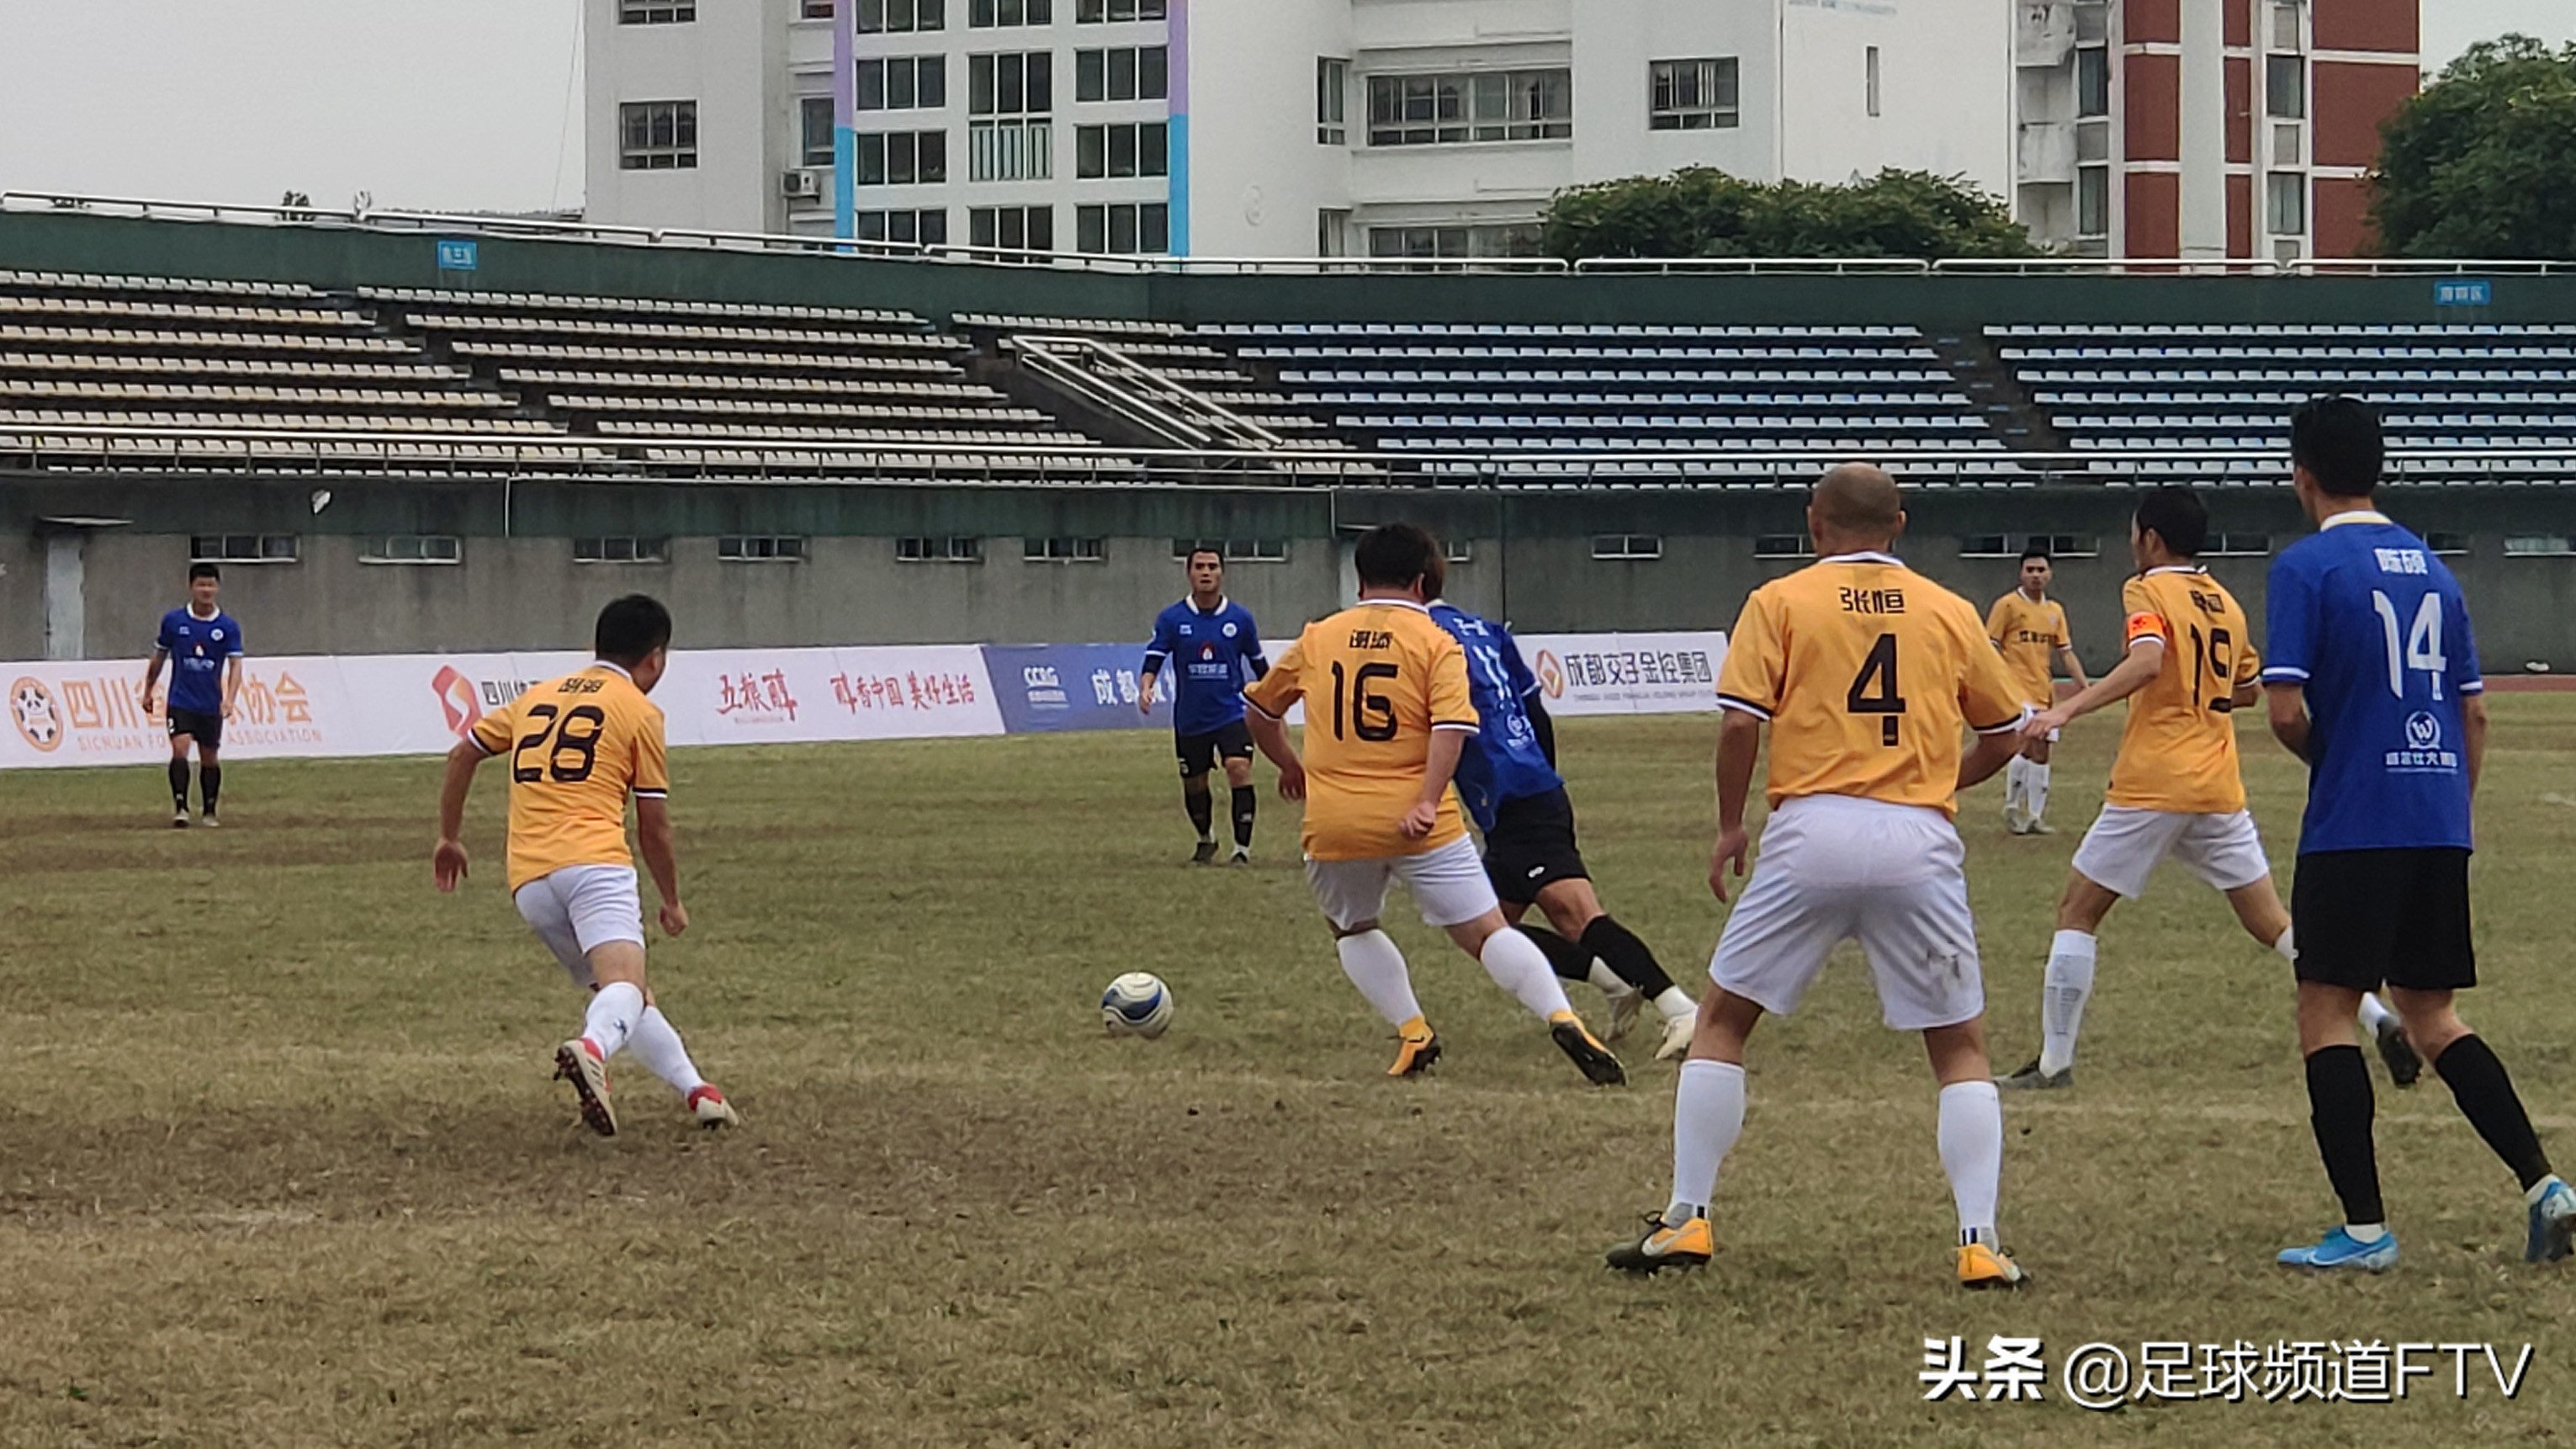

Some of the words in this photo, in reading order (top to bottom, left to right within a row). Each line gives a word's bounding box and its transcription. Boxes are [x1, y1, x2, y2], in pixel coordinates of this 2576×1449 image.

[1839, 586, 1906, 614] 张恒
[1564, 649, 1713, 687] 成都交子金控集团
[2190, 622, 2232, 714] 19
[2372, 590, 2447, 701] 14
[61, 671, 311, 729] 四川省协会
[907, 670, 975, 711] 美好生活
[1331, 660, 1399, 742] 16
[1847, 633, 1906, 746] 4
[513, 703, 605, 783] 28
